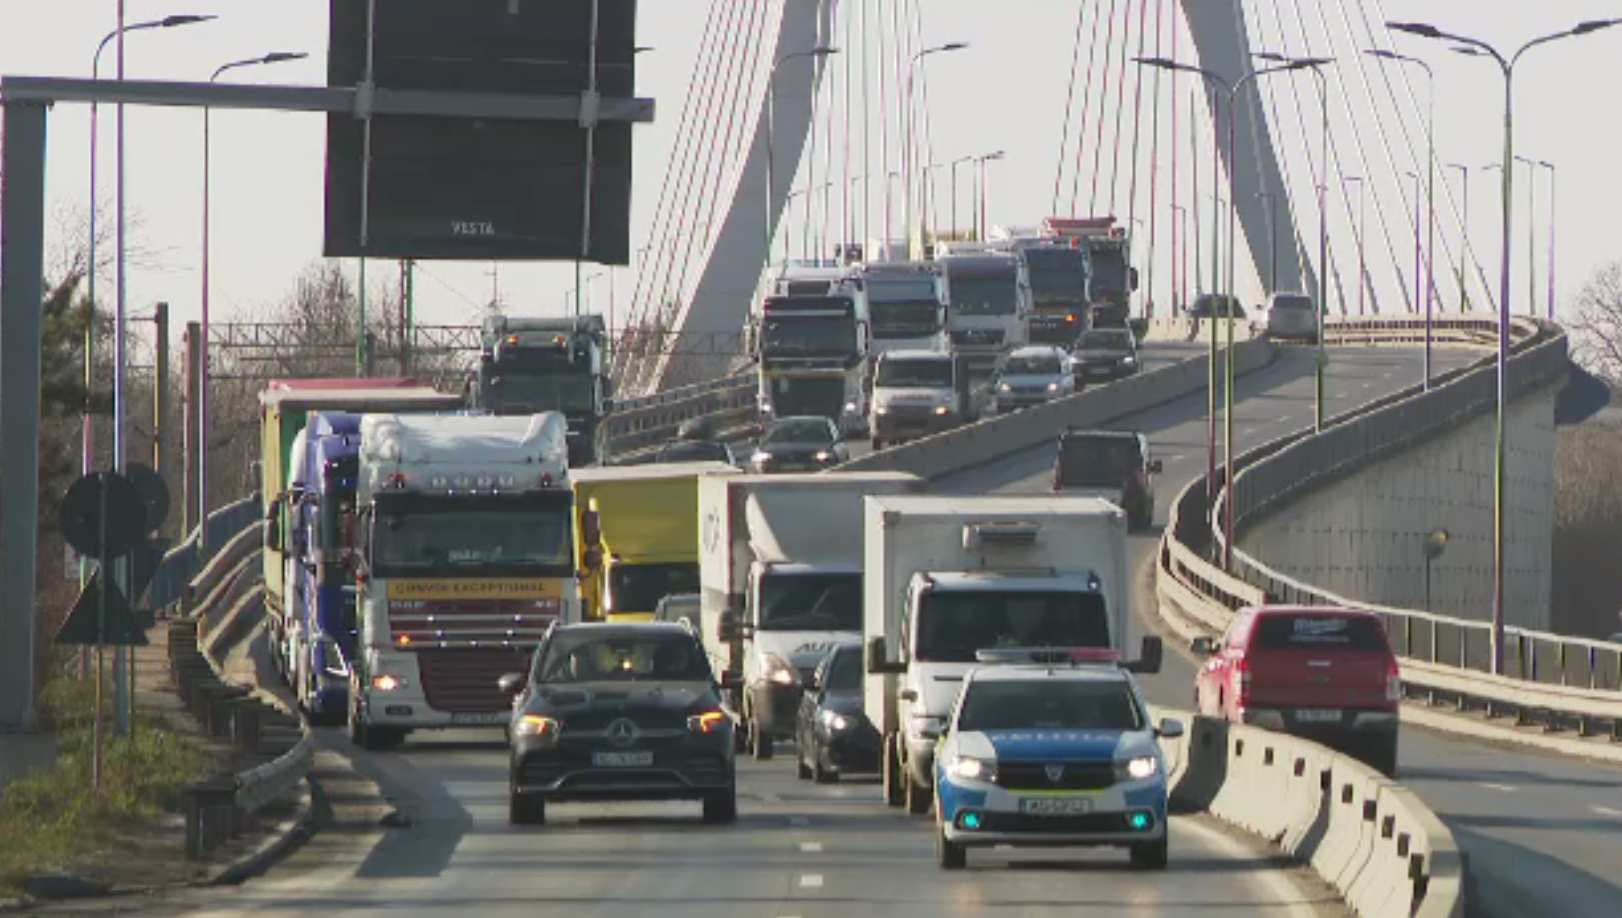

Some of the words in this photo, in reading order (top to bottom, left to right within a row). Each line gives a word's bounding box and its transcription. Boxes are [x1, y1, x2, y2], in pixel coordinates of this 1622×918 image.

[451, 220, 495, 235] VESTA
[395, 582, 448, 594] CONVOI
[453, 581, 545, 593] EXCEPTIONAL
